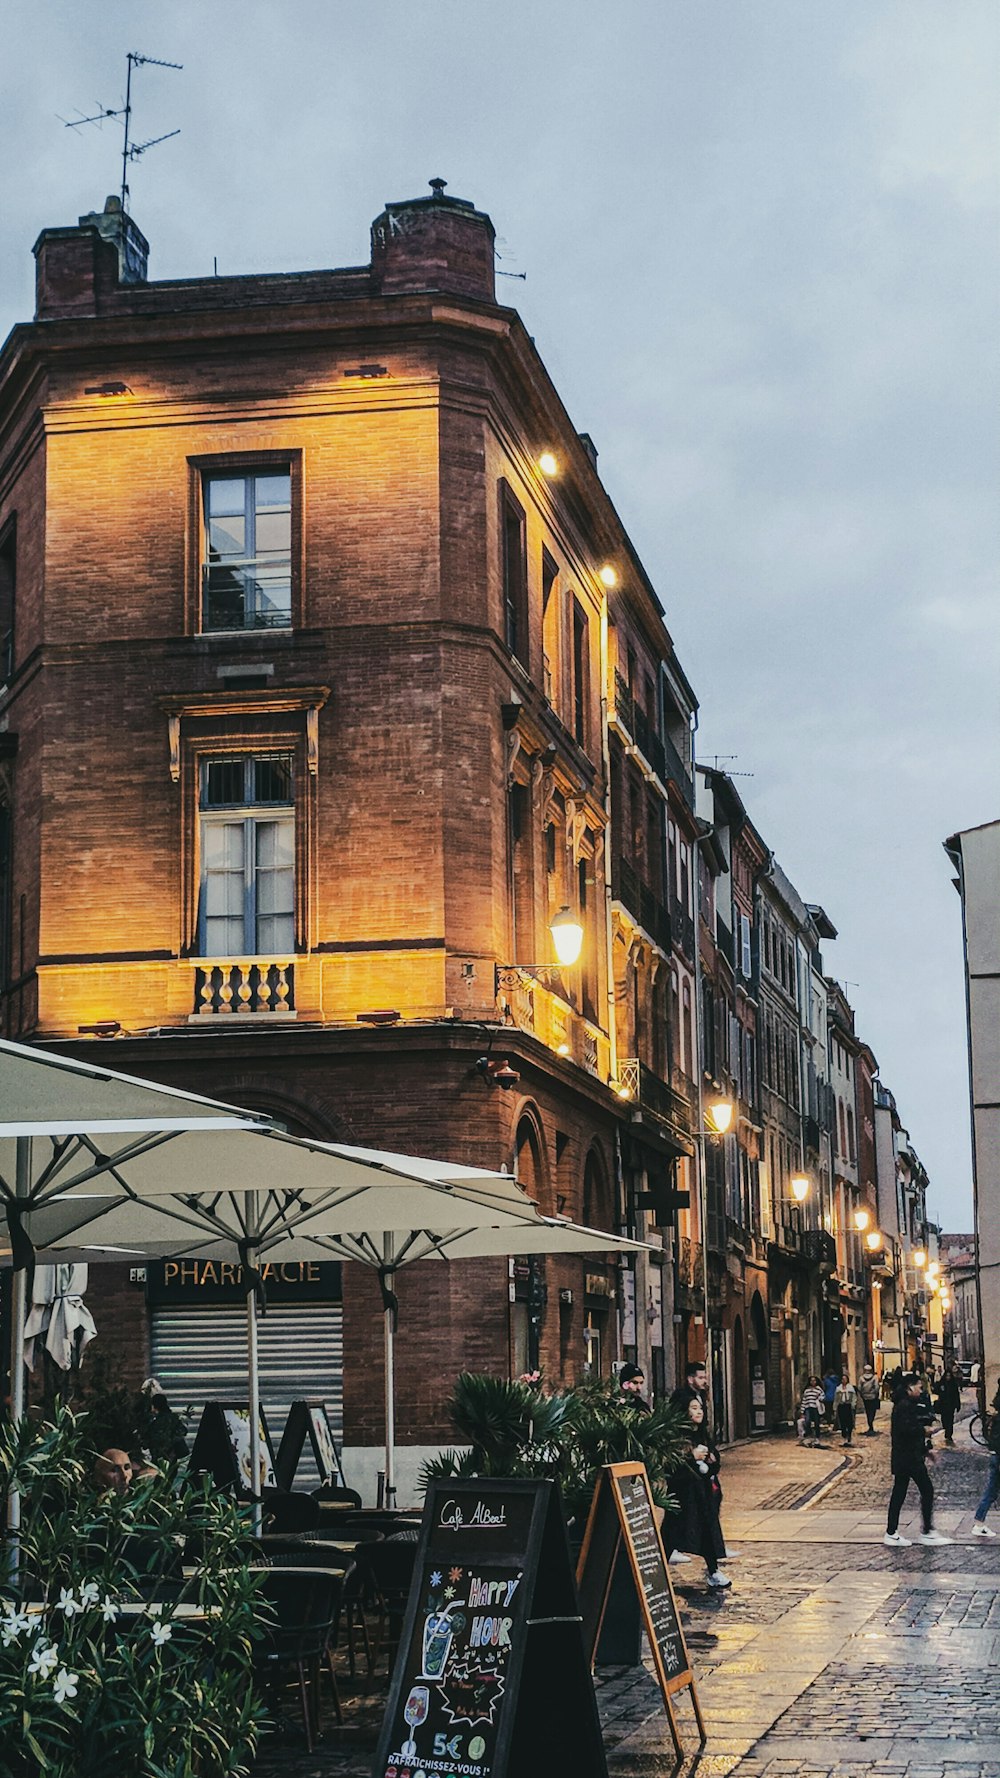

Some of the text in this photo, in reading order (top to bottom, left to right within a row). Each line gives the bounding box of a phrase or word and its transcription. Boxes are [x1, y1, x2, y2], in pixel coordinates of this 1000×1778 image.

[467, 1577, 520, 1608] HAPPY
[469, 1616, 513, 1648] HOUR
[432, 1732, 463, 1760] 5€
